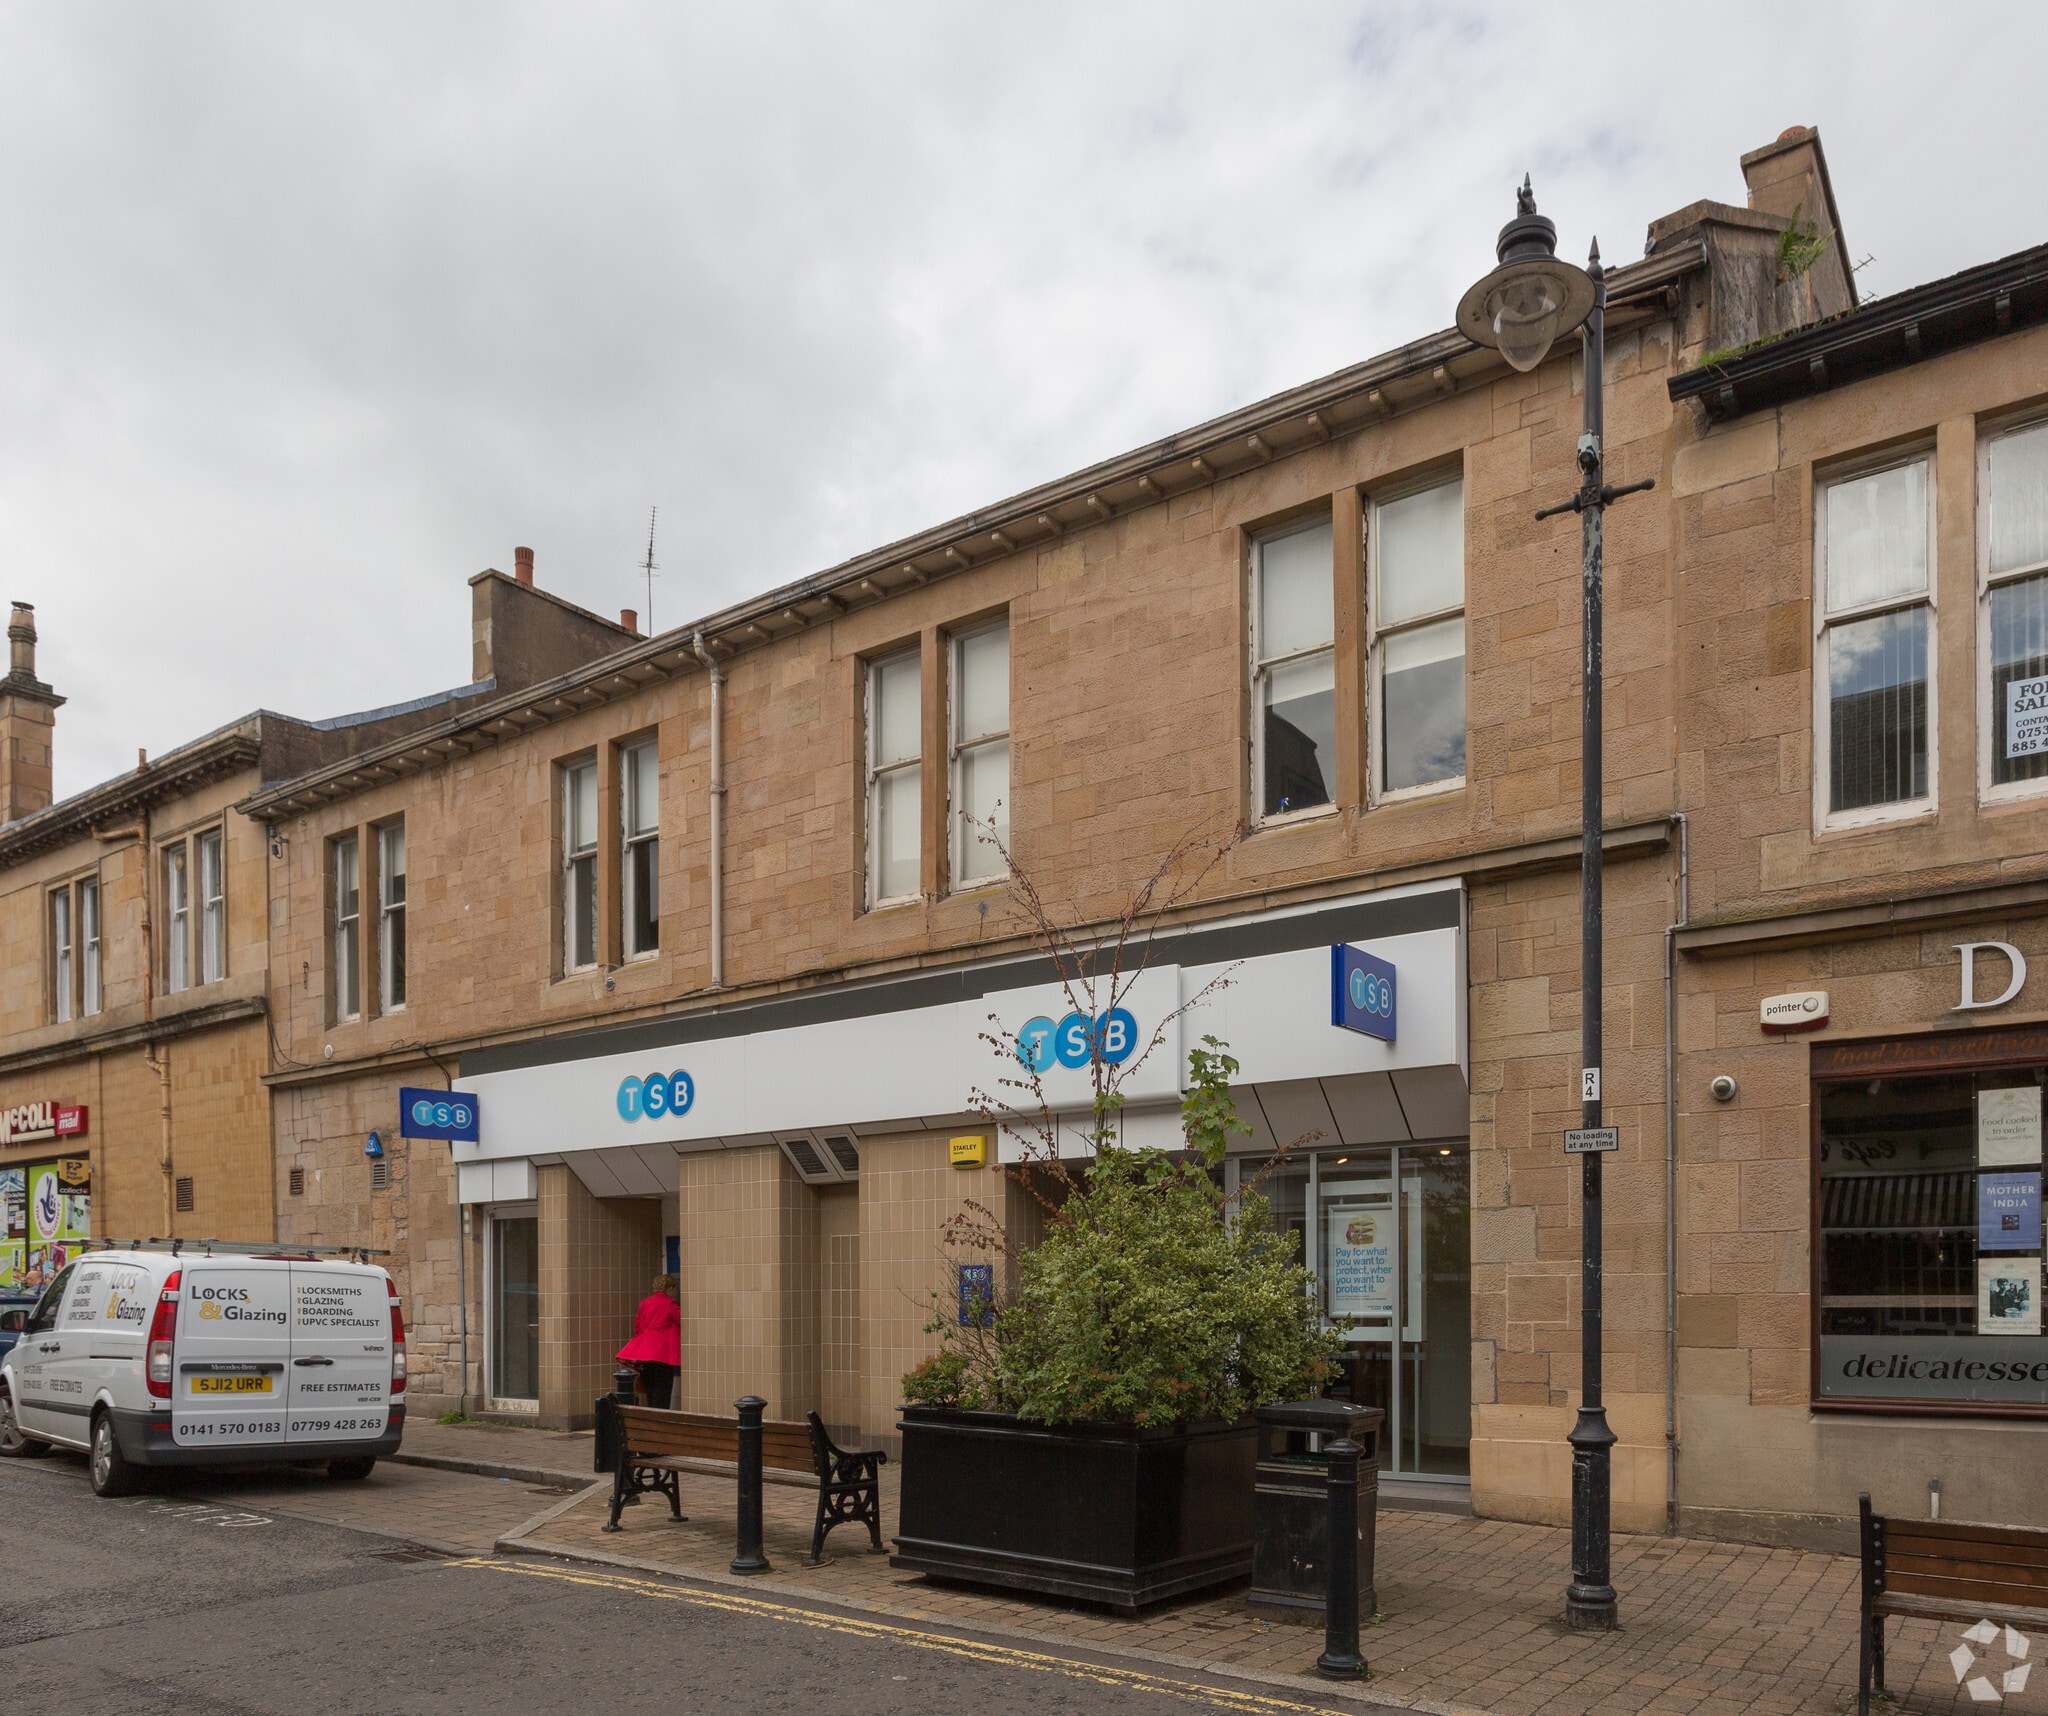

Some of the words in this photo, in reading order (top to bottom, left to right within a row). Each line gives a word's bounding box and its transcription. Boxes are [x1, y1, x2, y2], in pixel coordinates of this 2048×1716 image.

[2019, 681, 2048, 698] FO
[2012, 740, 2037, 752] 885
[1951, 941, 2027, 1010] D
[1354, 976, 1390, 1010] TSB
[1766, 1003, 1802, 1016] pointer
[1027, 1017, 1129, 1063] TSB
[1832, 1043, 1887, 1067] food
[1585, 1072, 1595, 1084] R
[622, 1077, 690, 1115] TSB
[1585, 1086, 1594, 1098] 4
[58, 1110, 79, 1130] mail
[418, 1104, 468, 1125] TSB
[1982, 1117, 2004, 1126] Food
[2006, 1114, 2038, 1124] cooked
[2004, 1126, 2026, 1134] order
[1986, 1186, 2034, 1195] MOTHER
[1993, 1199, 2028, 1208] INDIA
[1336, 1248, 1351, 1258] Pay
[1353, 1247, 1365, 1256] for
[1366, 1246, 1388, 1256] what
[1336, 1259, 1352, 1267] you
[1354, 1257, 1374, 1265] want
[1336, 1266, 1370, 1276] protect,
[1336, 1277, 1352, 1285] you
[1354, 1275, 1374, 1284] want
[1376, 1275, 1385, 1283] to
[302, 1287, 362, 1296] LOCKSMITHS
[1336, 1284, 1368, 1294] protect
[1368, 1284, 1376, 1292] it.
[302, 1297, 344, 1306] GLAZING
[116, 1298, 146, 1326] Glazing
[199, 1300, 222, 1320] &
[224, 1306, 287, 1324] Glazing
[302, 1308, 353, 1316] BOARDING
[302, 1318, 328, 1326] UPVC
[330, 1319, 380, 1327] SPECIALIST
[1842, 1354, 2048, 1382] delicatesse
[200, 1378, 232, 1391] SJ12
[236, 1378, 264, 1390] URR
[300, 1384, 324, 1392] FREE
[327, 1383, 381, 1392] ESTIMATES
[180, 1424, 214, 1435] 0141
[219, 1424, 244, 1434] 570
[248, 1422, 280, 1433] 0183
[292, 1420, 330, 1432] 07799
[334, 1420, 356, 1430] 428
[360, 1419, 382, 1428] 263
